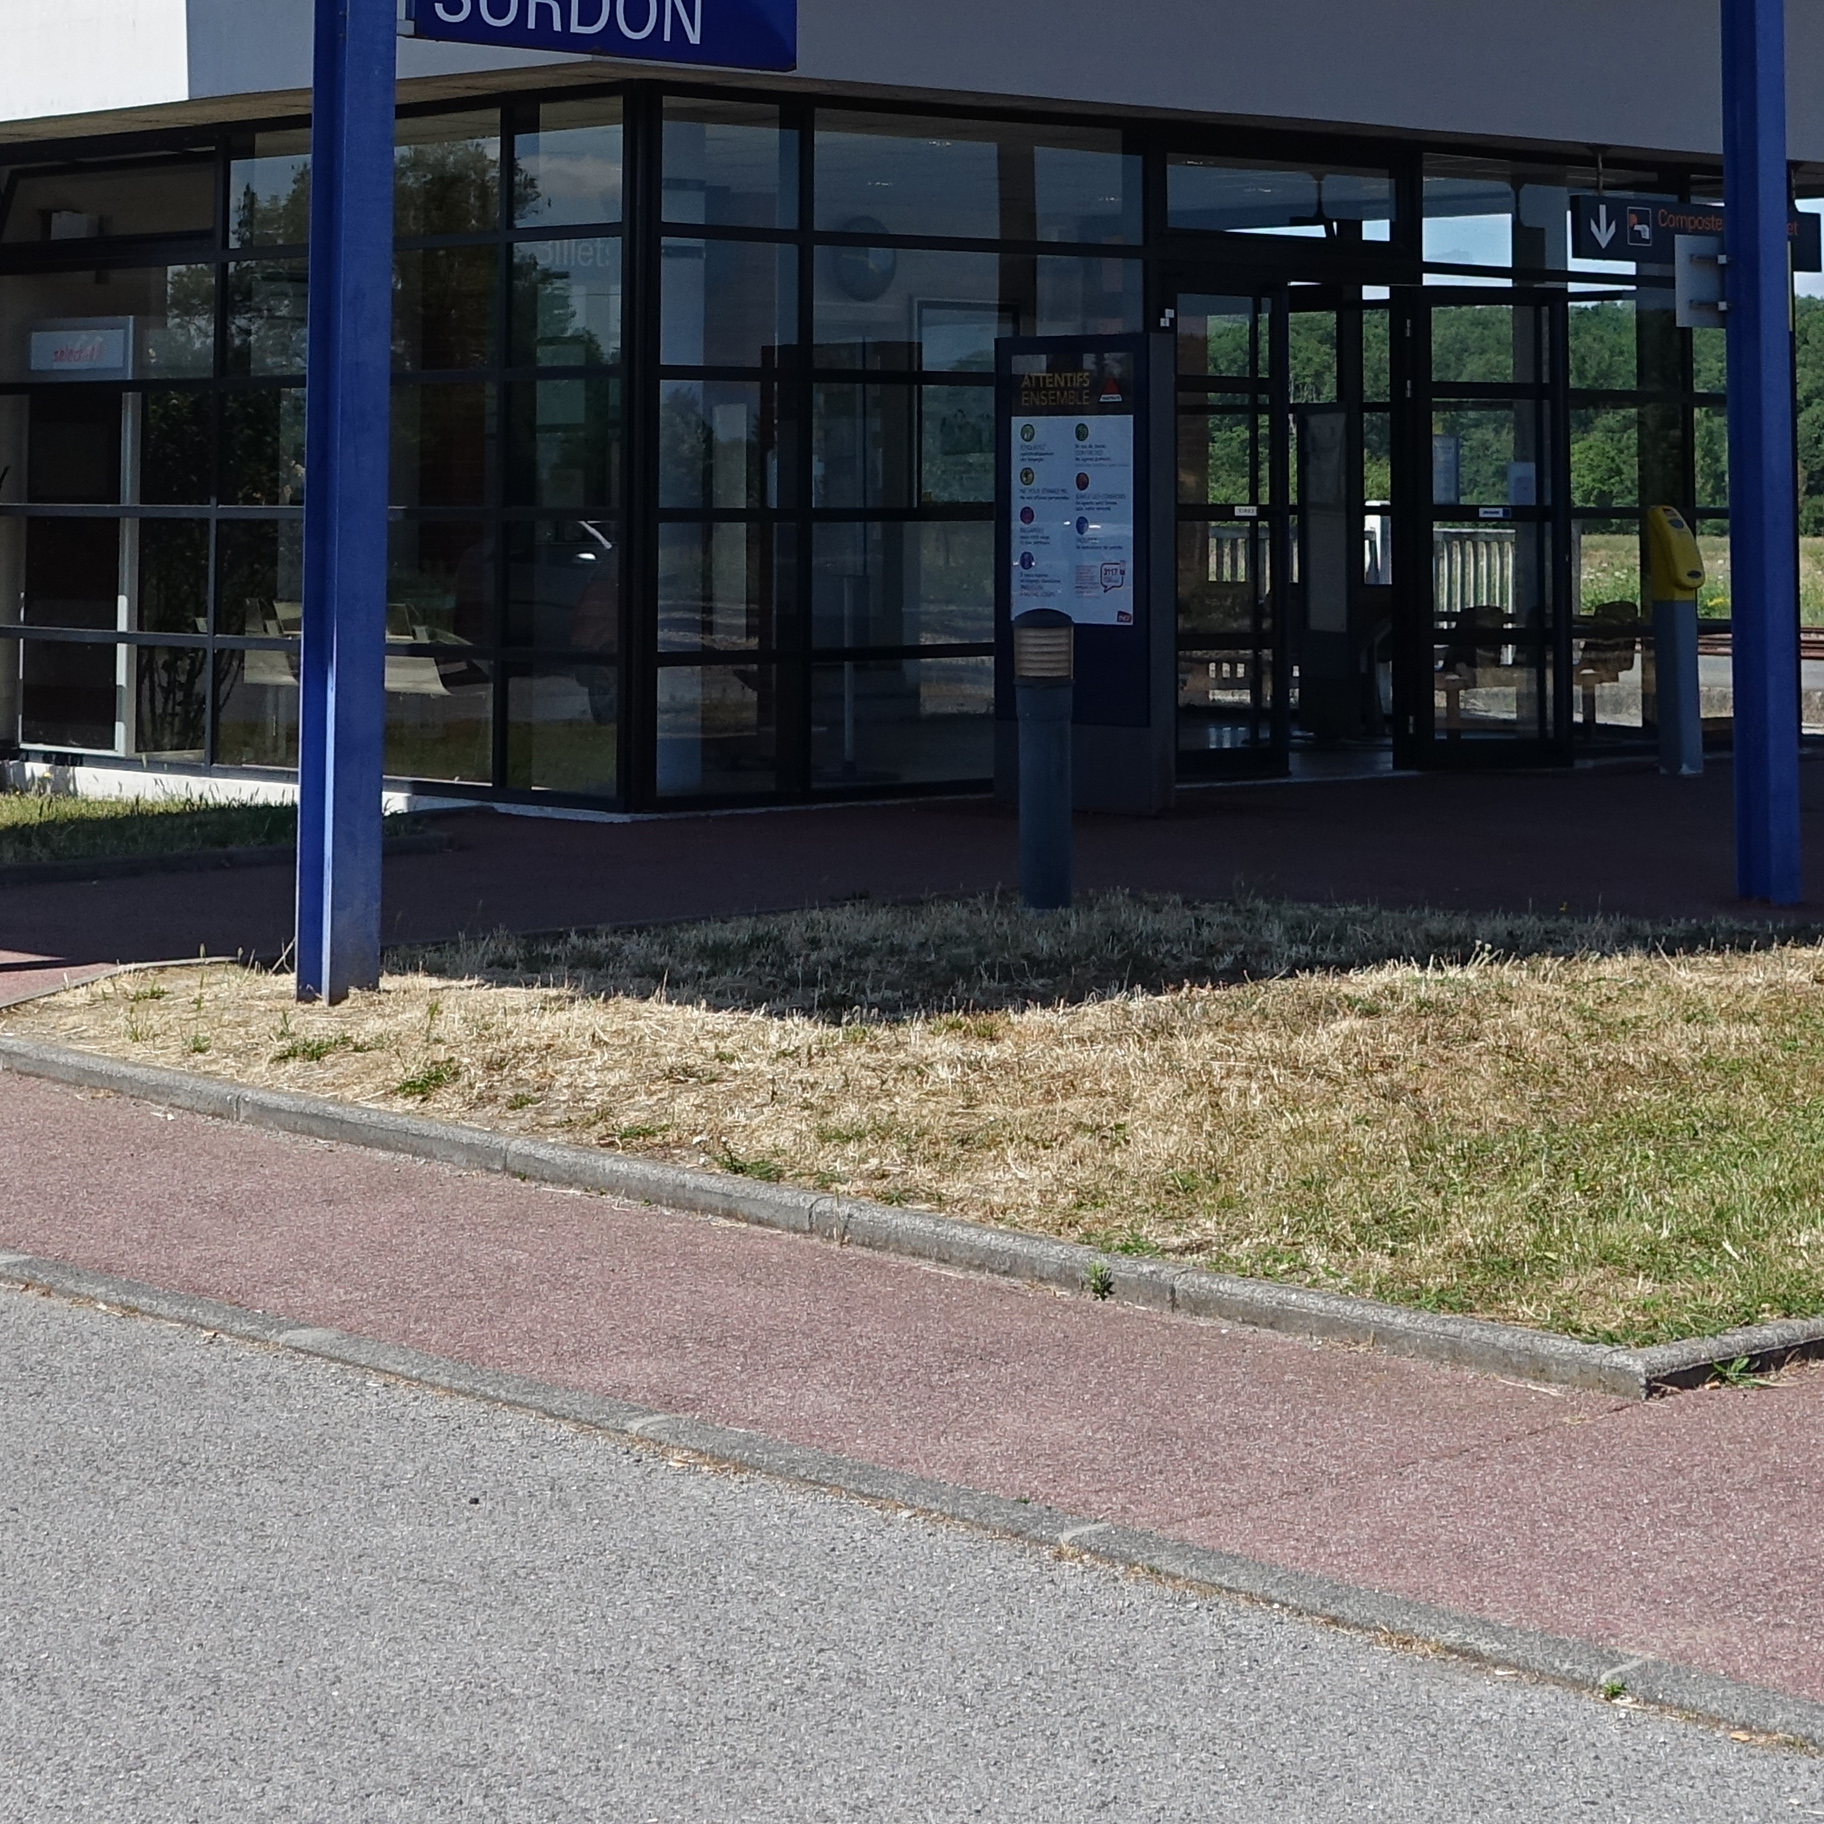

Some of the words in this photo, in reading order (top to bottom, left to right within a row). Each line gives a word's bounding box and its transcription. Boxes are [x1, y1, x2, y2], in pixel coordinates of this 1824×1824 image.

[1657, 208, 1725, 233] Composte
[1021, 371, 1091, 388] ATTENTIFS
[1021, 390, 1091, 406] ENSEMBLE
